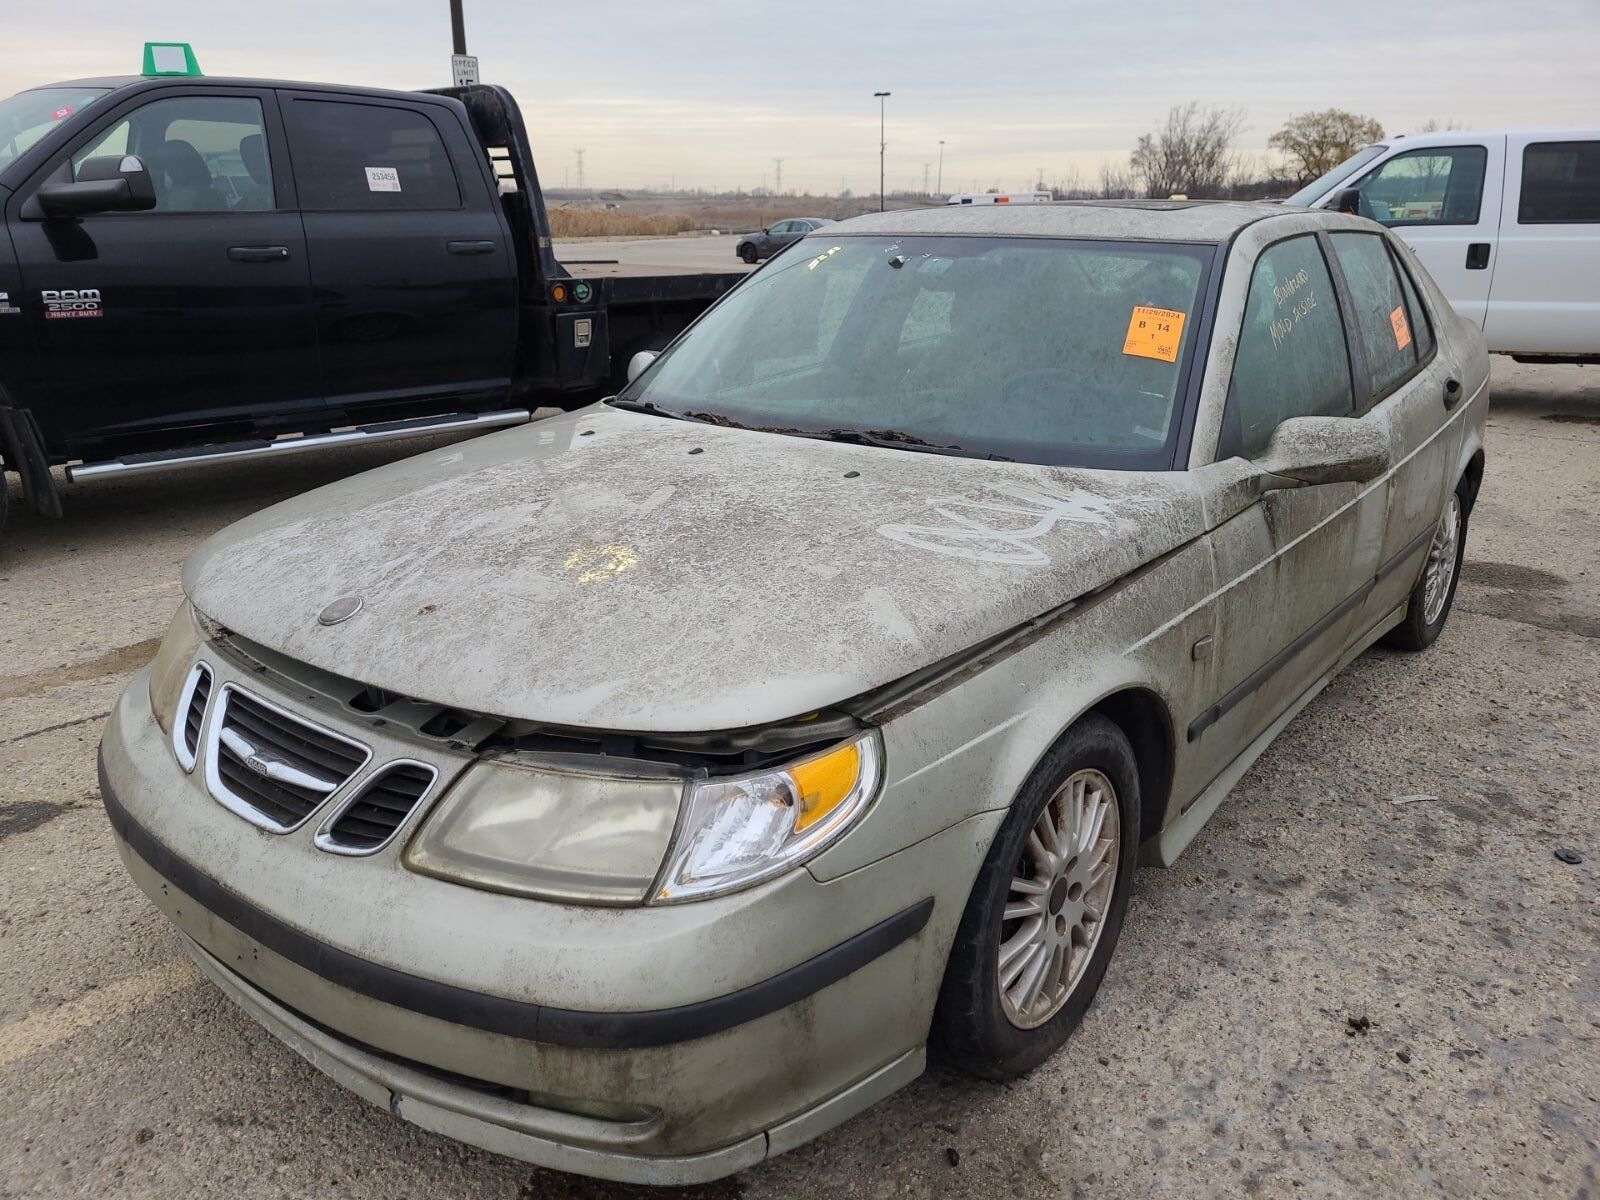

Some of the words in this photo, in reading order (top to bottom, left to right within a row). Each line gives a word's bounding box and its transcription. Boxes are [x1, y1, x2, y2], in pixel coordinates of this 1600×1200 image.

[454, 59, 477, 68] SPEED
[41, 289, 102, 304] RAM
[48, 302, 98, 311] 2500
[1138, 320, 1147, 329] B
[1157, 323, 1171, 333] 14
[1269, 318, 1292, 351] MOLD
[1292, 290, 1317, 323] INSIDE
